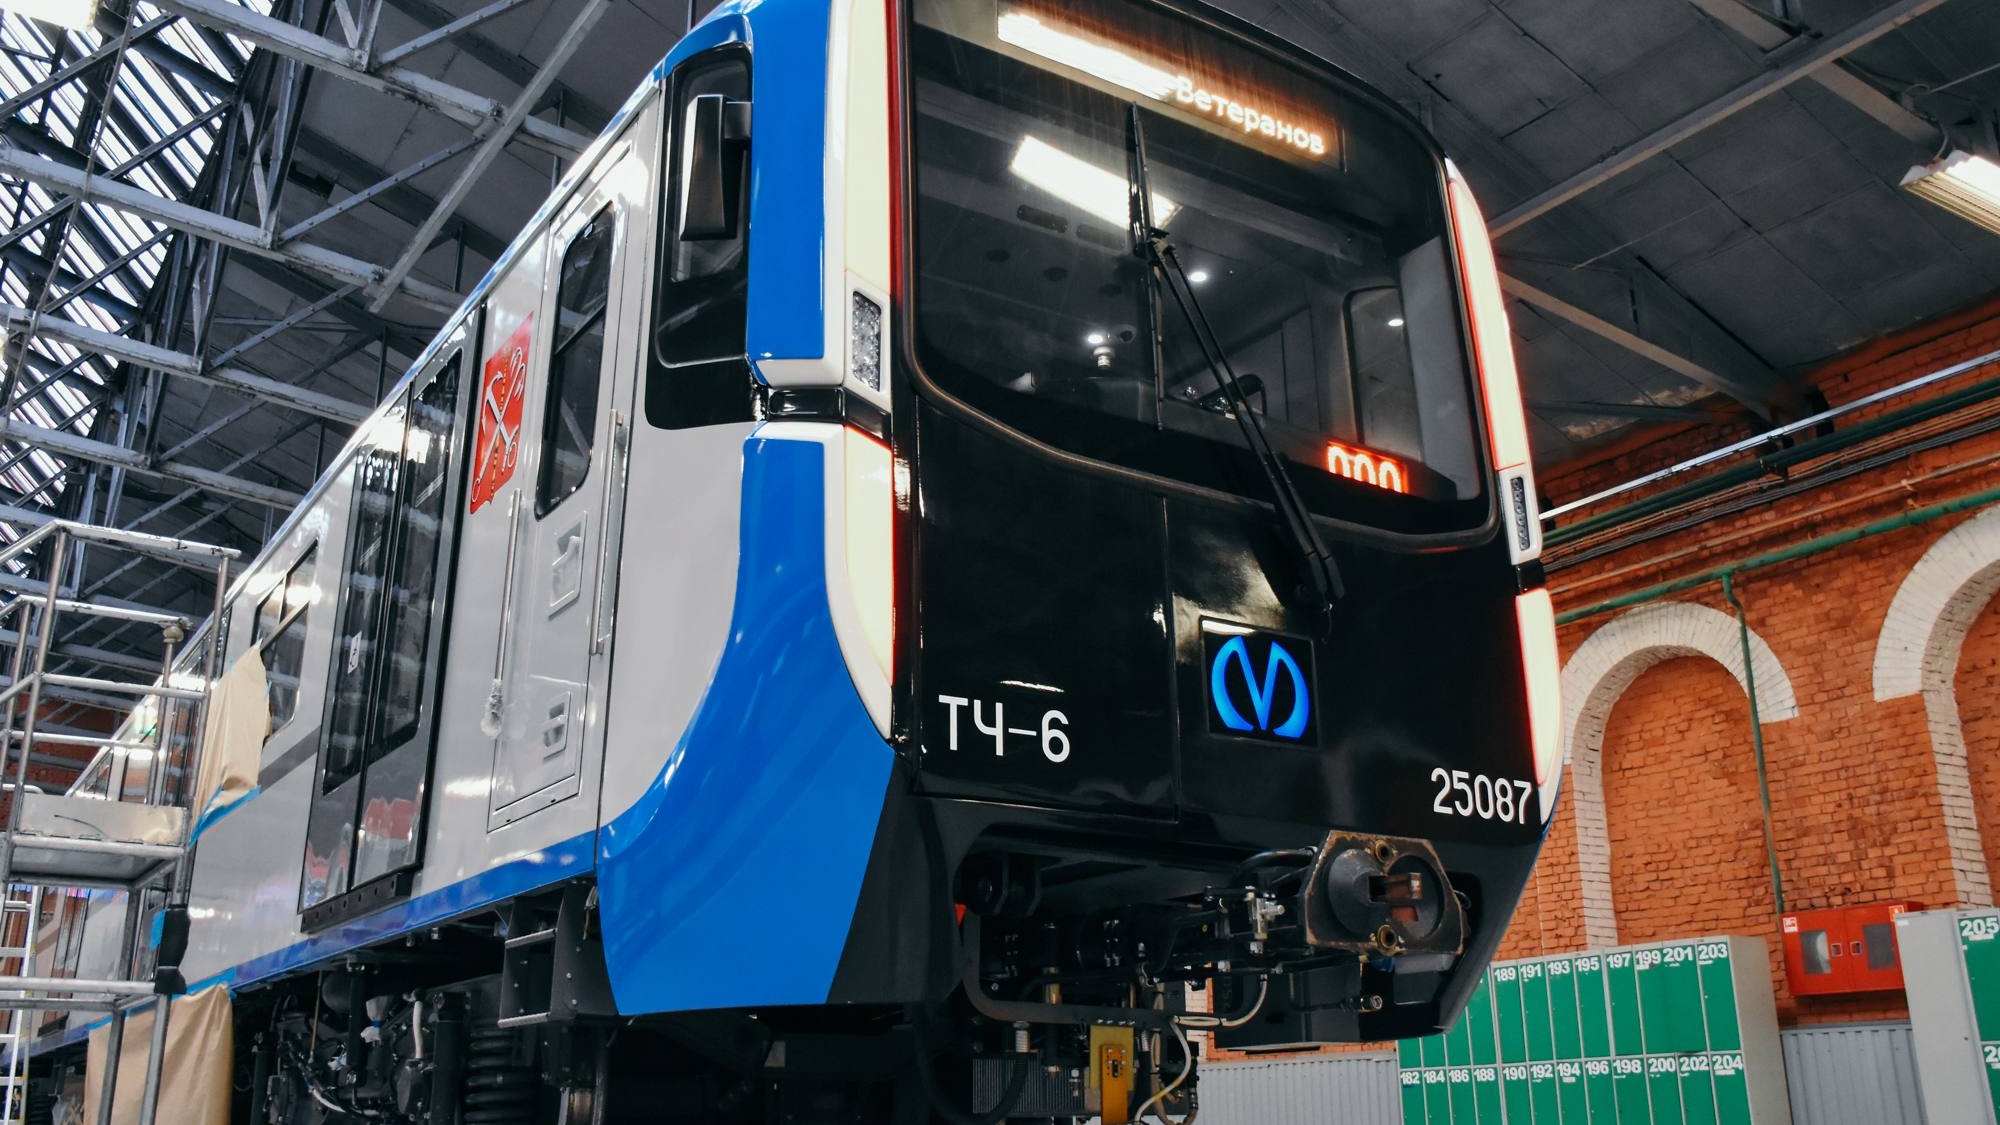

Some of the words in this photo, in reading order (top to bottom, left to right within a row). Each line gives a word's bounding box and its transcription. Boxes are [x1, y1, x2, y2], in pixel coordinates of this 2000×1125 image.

[1176, 75, 1325, 155] Ветеранов
[938, 694, 1070, 763] ТЧ-6
[1430, 767, 1532, 824] 25087
[1960, 917, 1999, 937] 205
[1636, 949, 1661, 965] 199
[1663, 946, 1693, 962] 201
[1698, 943, 1728, 960] 203
[1547, 960, 1570, 975] 193
[1576, 957, 1600, 972] 195
[1606, 953, 1631, 968] 197
[1494, 967, 1516, 982] 189
[1520, 964, 1542, 978] 191
[1556, 1062, 1580, 1077] 194
[1585, 1061, 1609, 1075] 196
[1613, 1059, 1642, 1073] 198
[1648, 1057, 1676, 1072] 200
[1680, 1056, 1708, 1072] 202
[1712, 1054, 1743, 1070] 204
[1400, 1071, 1420, 1085] 182
[1423, 1070, 1445, 1083] 184
[1449, 1069, 1469, 1083] 186
[1473, 1068, 1495, 1081] 188
[1503, 1066, 1526, 1080] 190
[1530, 1064, 1553, 1078] 192
